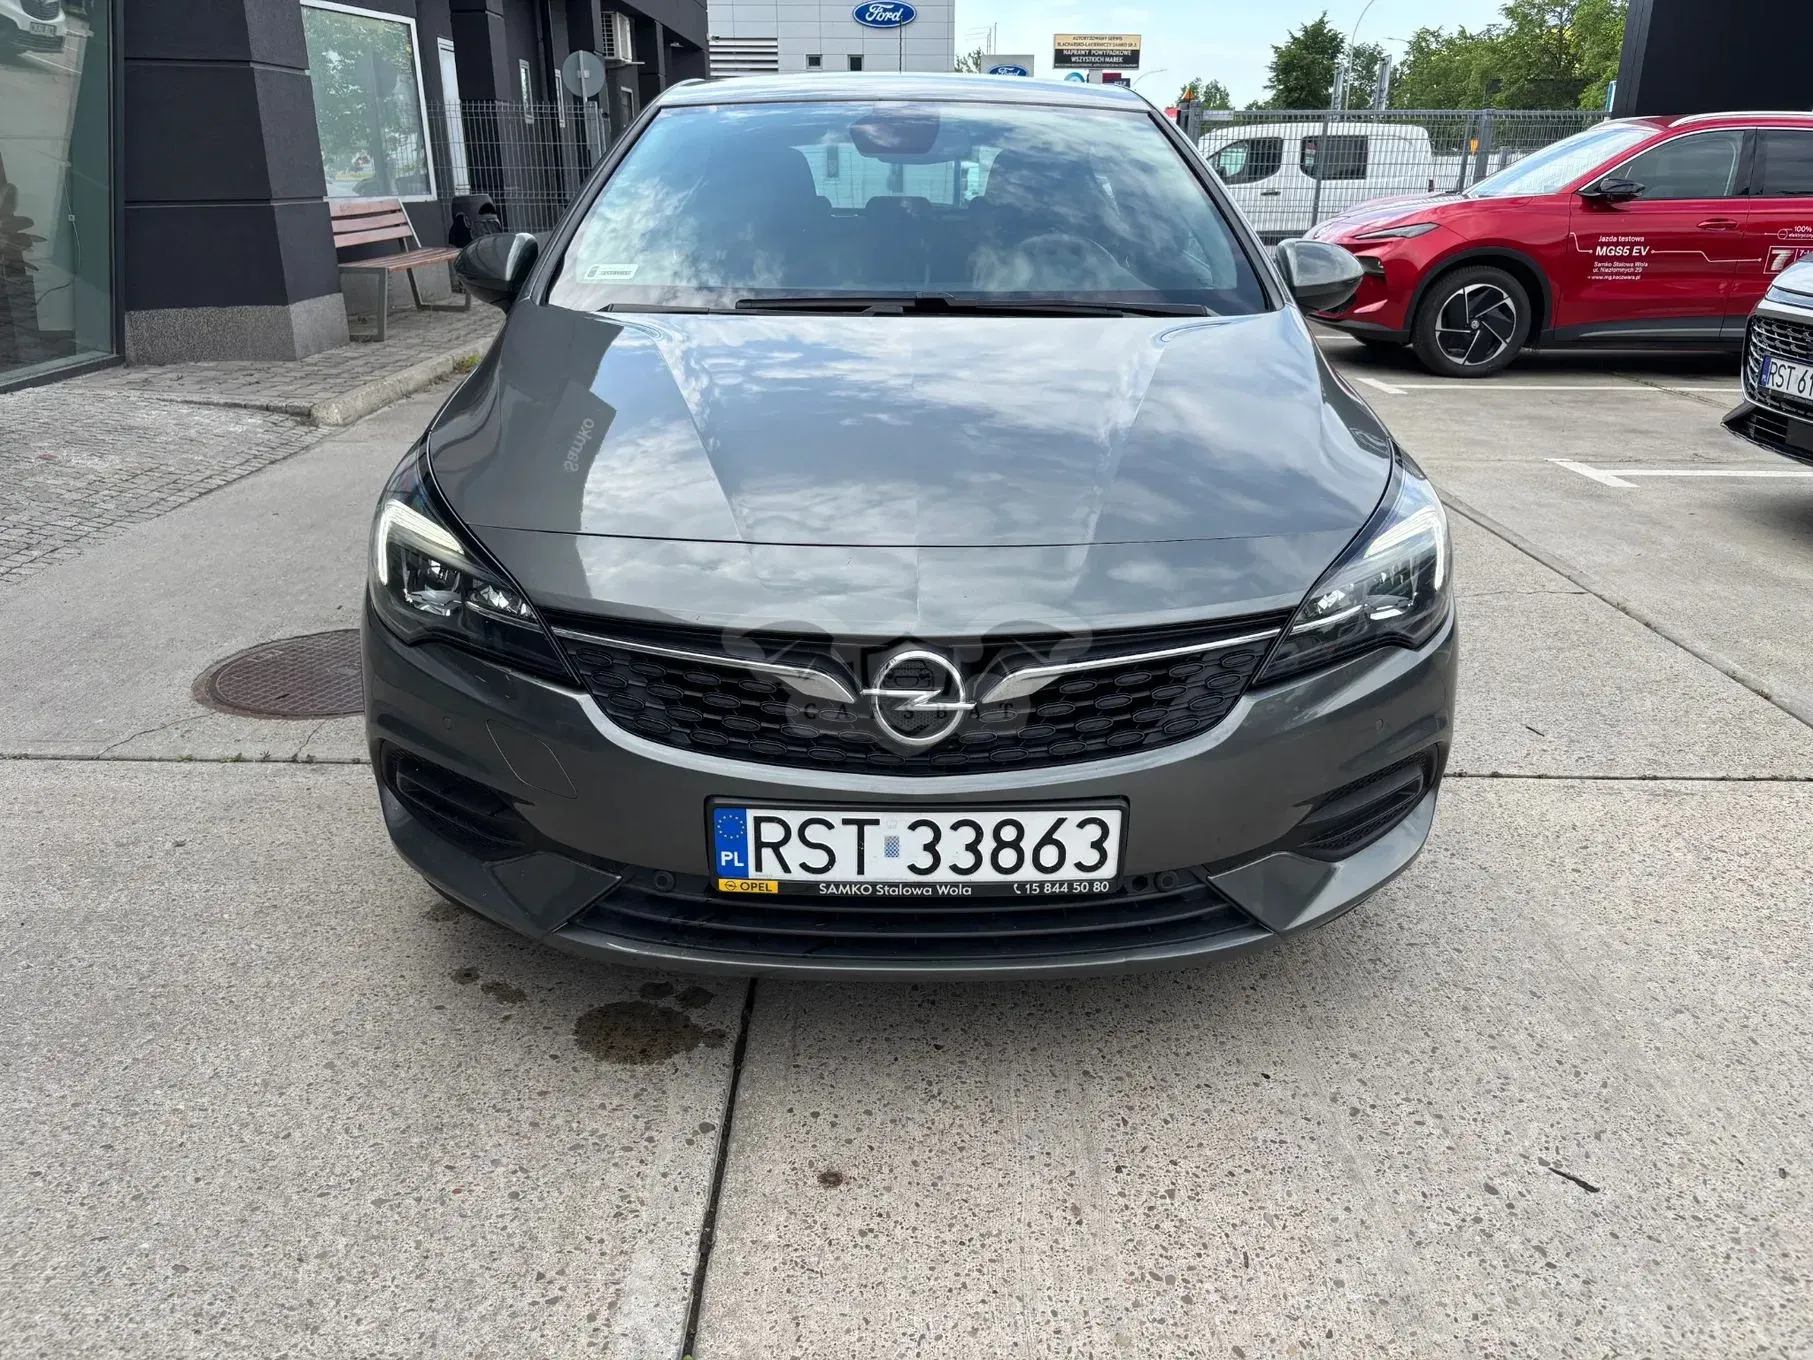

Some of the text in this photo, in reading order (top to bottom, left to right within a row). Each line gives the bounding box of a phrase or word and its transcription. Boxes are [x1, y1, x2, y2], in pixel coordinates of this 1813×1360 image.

[865, 3, 903, 22] Ford
[1595, 246, 1650, 256] MGS5 EV
[1770, 361, 1796, 391] RST
[753, 815, 1111, 876] RST 33863
[720, 851, 744, 867] PL
[739, 881, 773, 892] OPEL
[819, 883, 972, 896] SAMKO Stalowa Wola
[1025, 881, 1110, 894] 15 844 50 80
